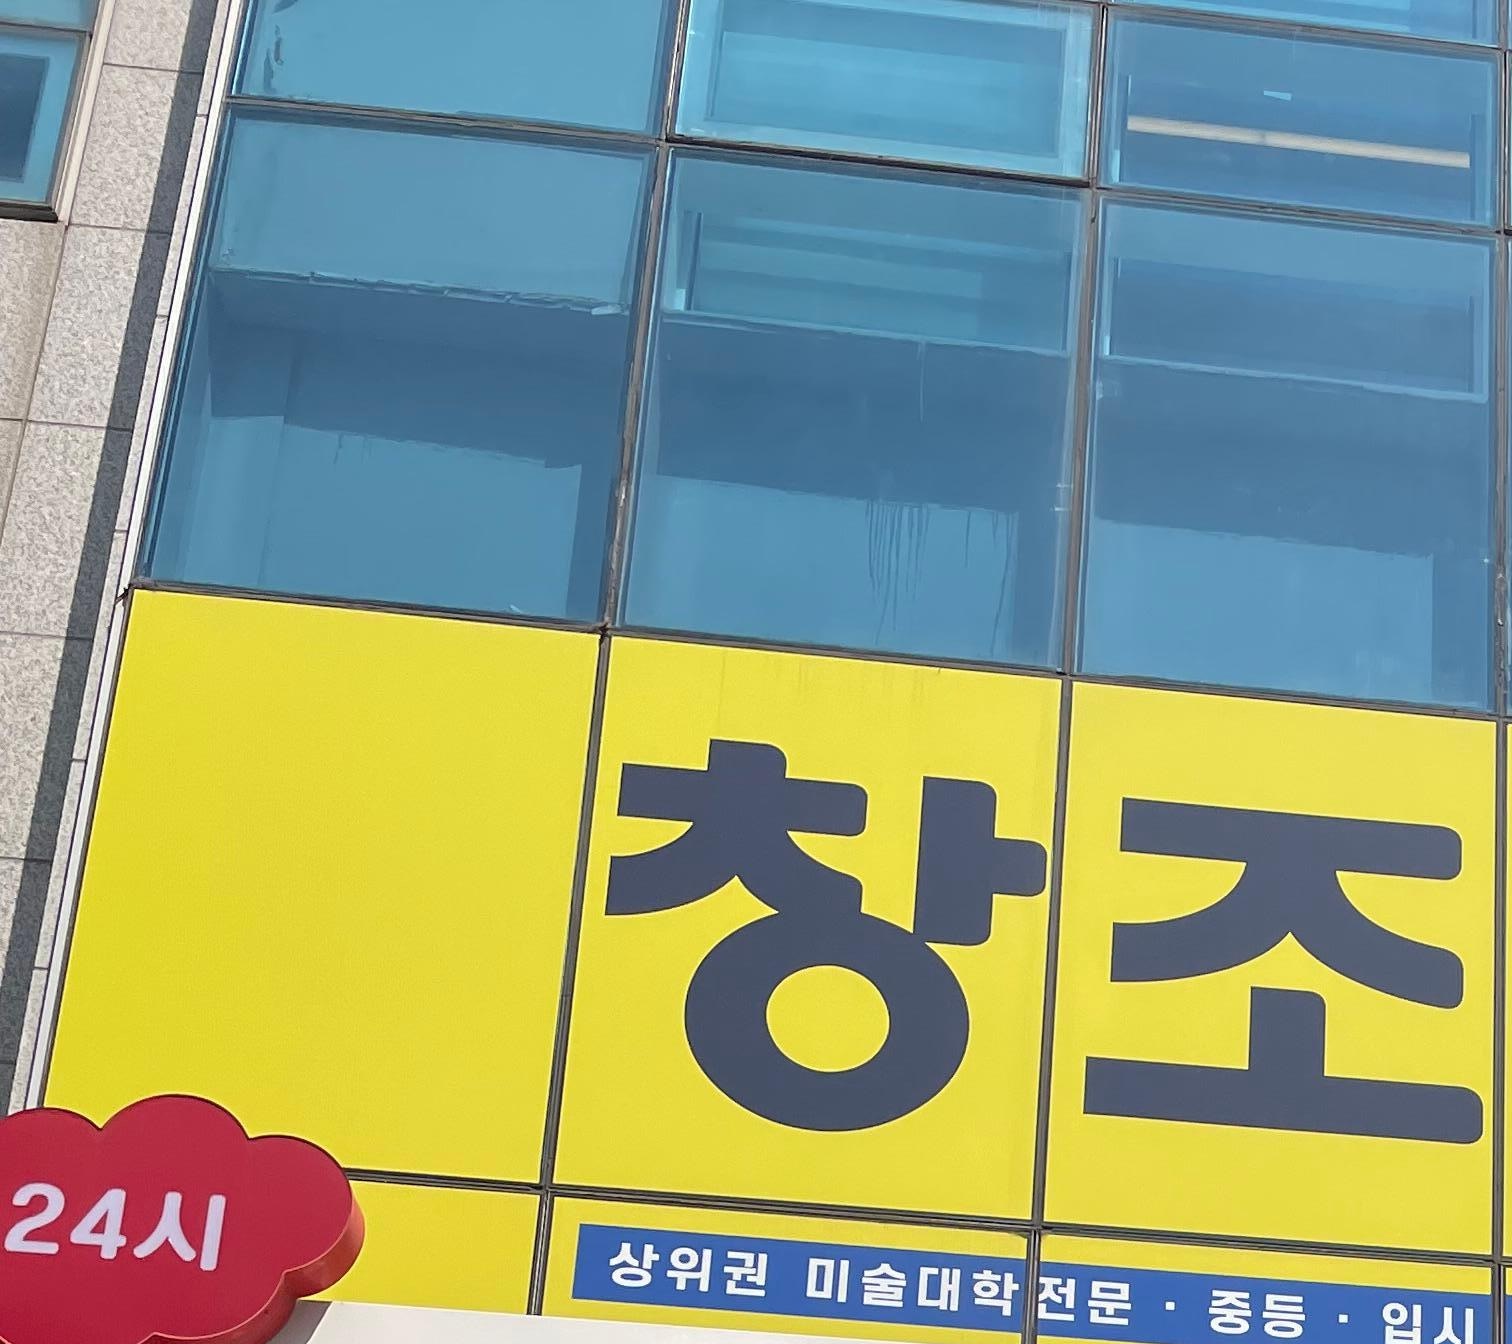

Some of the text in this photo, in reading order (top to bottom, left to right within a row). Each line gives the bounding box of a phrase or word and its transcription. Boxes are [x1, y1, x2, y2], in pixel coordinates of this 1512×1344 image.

[4, 1183, 226, 1271] 24시
[609, 1241, 767, 1298] 상위권
[1208, 1289, 1305, 1339] 중등
